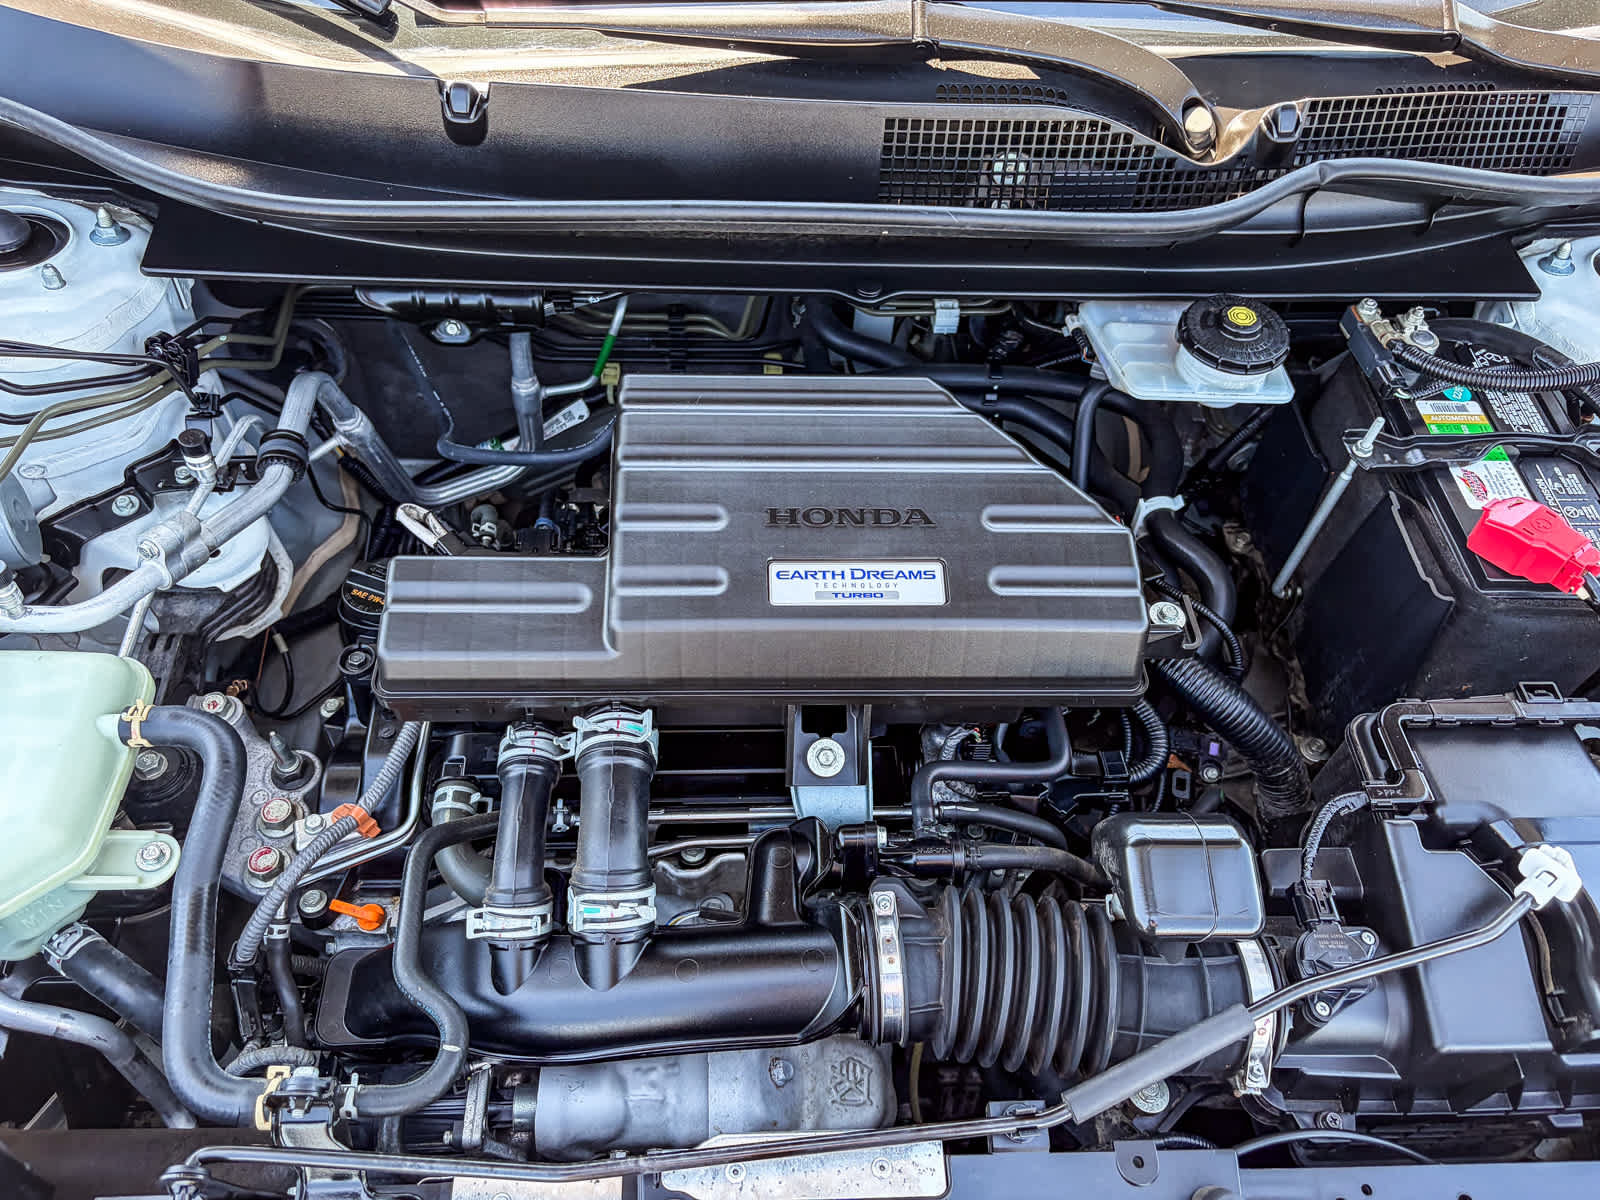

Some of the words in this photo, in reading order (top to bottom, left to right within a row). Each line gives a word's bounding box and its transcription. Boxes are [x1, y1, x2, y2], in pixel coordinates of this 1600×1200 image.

[766, 507, 936, 528] HONDA
[775, 570, 846, 581] EARTH
[849, 567, 937, 581] DREAMS
[814, 581, 899, 590] TECHNOLOGY
